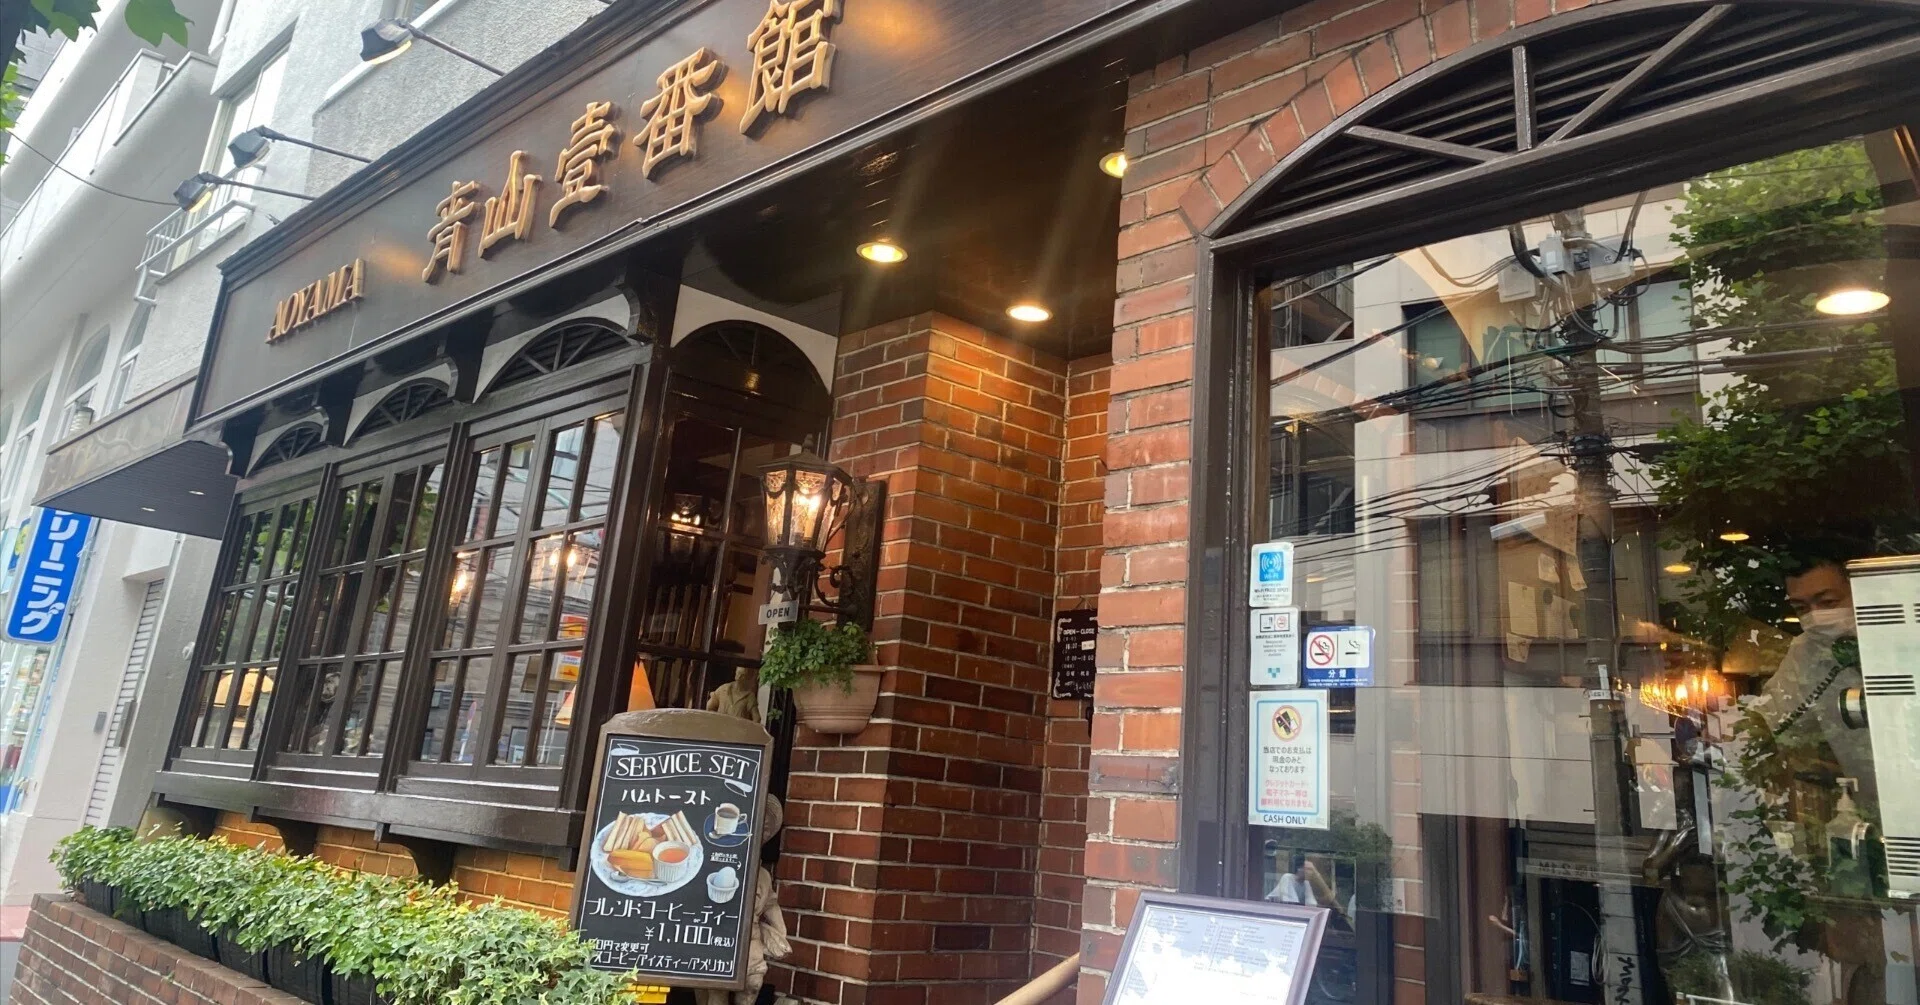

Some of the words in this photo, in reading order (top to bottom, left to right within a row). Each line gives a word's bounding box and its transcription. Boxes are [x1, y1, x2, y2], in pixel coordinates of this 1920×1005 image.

[264, 258, 365, 344] AOYAMA
[20, 511, 79, 634] リーニング
[766, 607, 790, 618] OPEN
[1263, 746, 1312, 754] 当店でのお支払は
[1272, 756, 1302, 764] 現金のみと
[615, 752, 702, 777] SERVICE
[708, 754, 750, 780] SET
[1269, 766, 1306, 774] なっております
[621, 788, 711, 805] ハムトースト
[1263, 814, 1284, 824] CASH
[1285, 815, 1308, 825] ONLY
